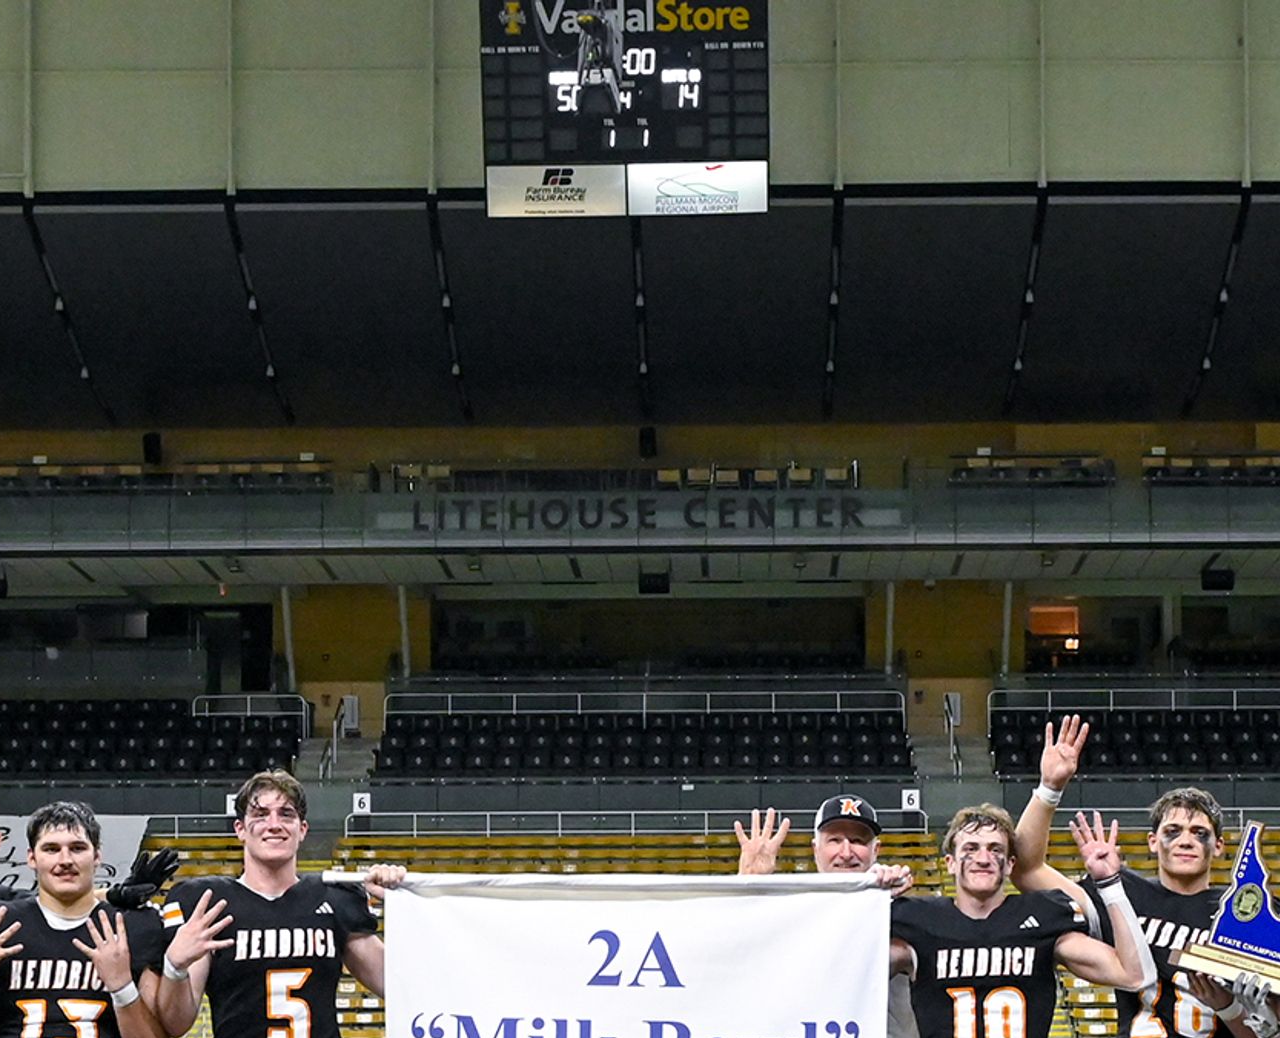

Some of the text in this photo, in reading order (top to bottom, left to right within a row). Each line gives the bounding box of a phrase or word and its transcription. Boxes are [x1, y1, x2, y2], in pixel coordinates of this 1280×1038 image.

[531, 0, 750, 35] VaalStore
[620, 91, 631, 109] 4
[678, 84, 699, 108] 14
[609, 129, 616, 147] 1
[643, 129, 650, 147] 1
[524, 193, 585, 202] INSURANCE
[526, 186, 587, 194] Farm Bureau
[656, 204, 738, 213] REGIONAL AIRPORT
[413, 496, 865, 532] LITEHOUSE CENTER
[358, 797, 366, 809] 6
[840, 799, 862, 817] K
[907, 793, 915, 806] 6
[1237, 839, 1254, 879] IDAHO
[235, 929, 336, 961] KENDRICK
[1217, 934, 1242, 949] STATE
[587, 929, 686, 988] 2A
[936, 946, 1036, 980] KENDRICK
